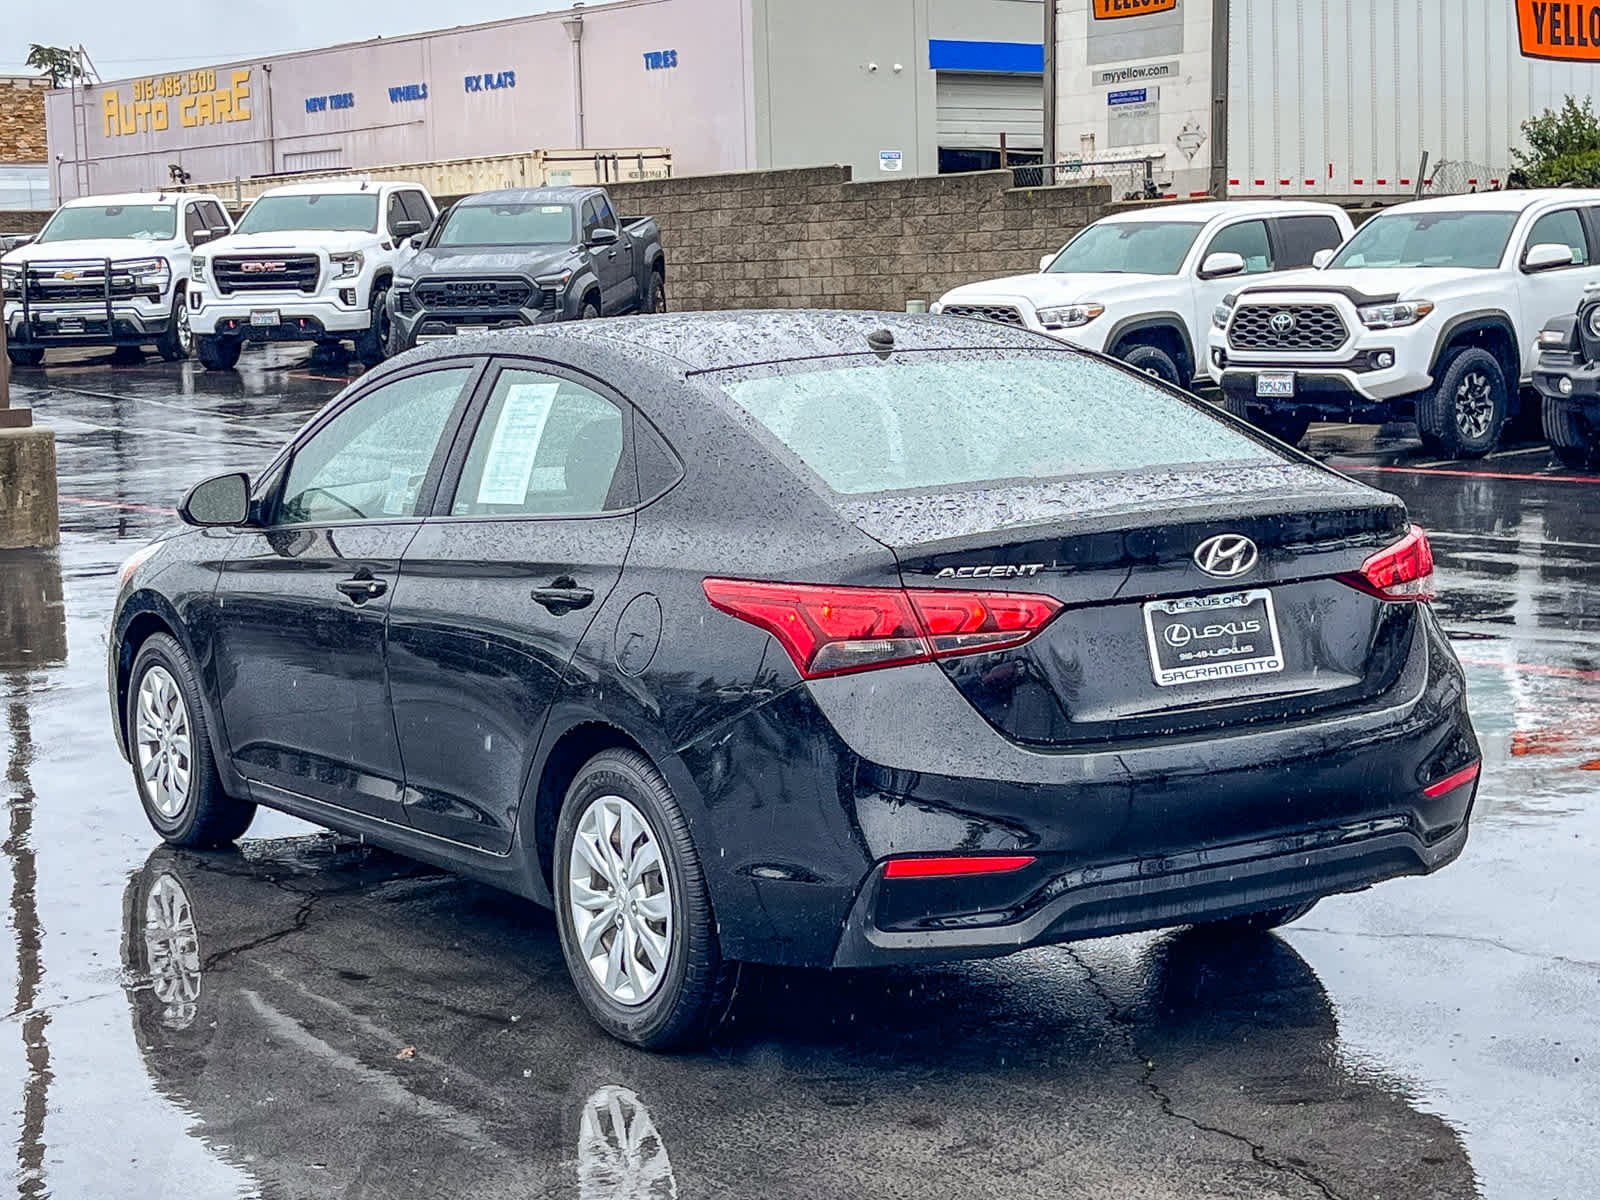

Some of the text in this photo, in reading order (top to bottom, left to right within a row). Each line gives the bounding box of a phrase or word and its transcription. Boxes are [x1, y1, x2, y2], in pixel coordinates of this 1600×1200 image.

[1532, 1, 1600, 47] YELLO
[643, 49, 678, 70] TIRES
[465, 70, 516, 93] FIX FLATS
[1102, 65, 1169, 83] myyellow.com
[102, 70, 251, 138] AUTO CARE
[305, 92, 355, 114] NEW TIRES
[388, 83, 428, 104] WHEELS
[241, 262, 287, 273] GMC
[934, 563, 1044, 580] ACCENT
[1174, 595, 1241, 610] LEXUS OF
[1191, 620, 1261, 639] LEXUS
[1161, 659, 1279, 683] SACRAMENTO
